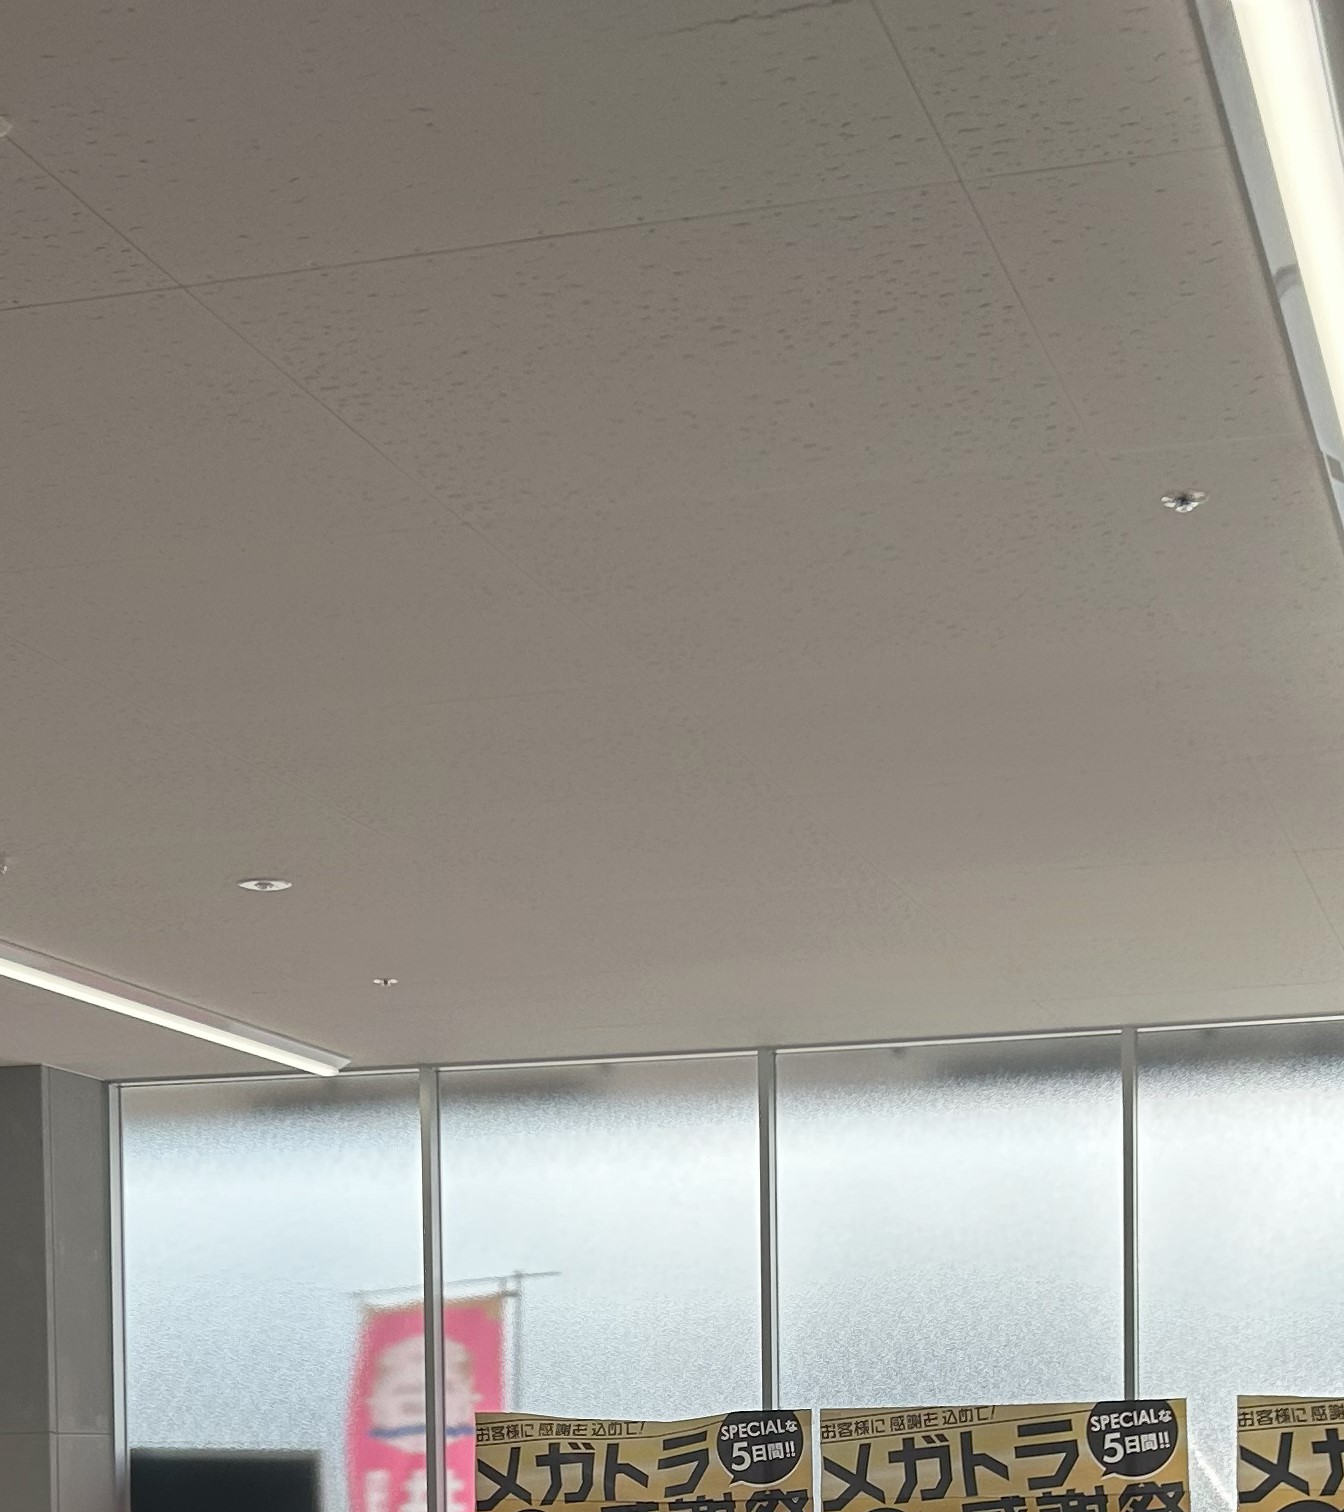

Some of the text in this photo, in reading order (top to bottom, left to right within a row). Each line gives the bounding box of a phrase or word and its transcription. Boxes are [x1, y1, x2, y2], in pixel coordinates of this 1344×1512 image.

[720, 1418, 799, 1441] SPECIALな
[1090, 1408, 1173, 1433] SPECIALな
[730, 1441, 797, 1472] 5日間!!
[1102, 1431, 1171, 1465] 5日間!!
[476, 1431, 709, 1511] メガトラ
[823, 1419, 1079, 1512] メガトラ
